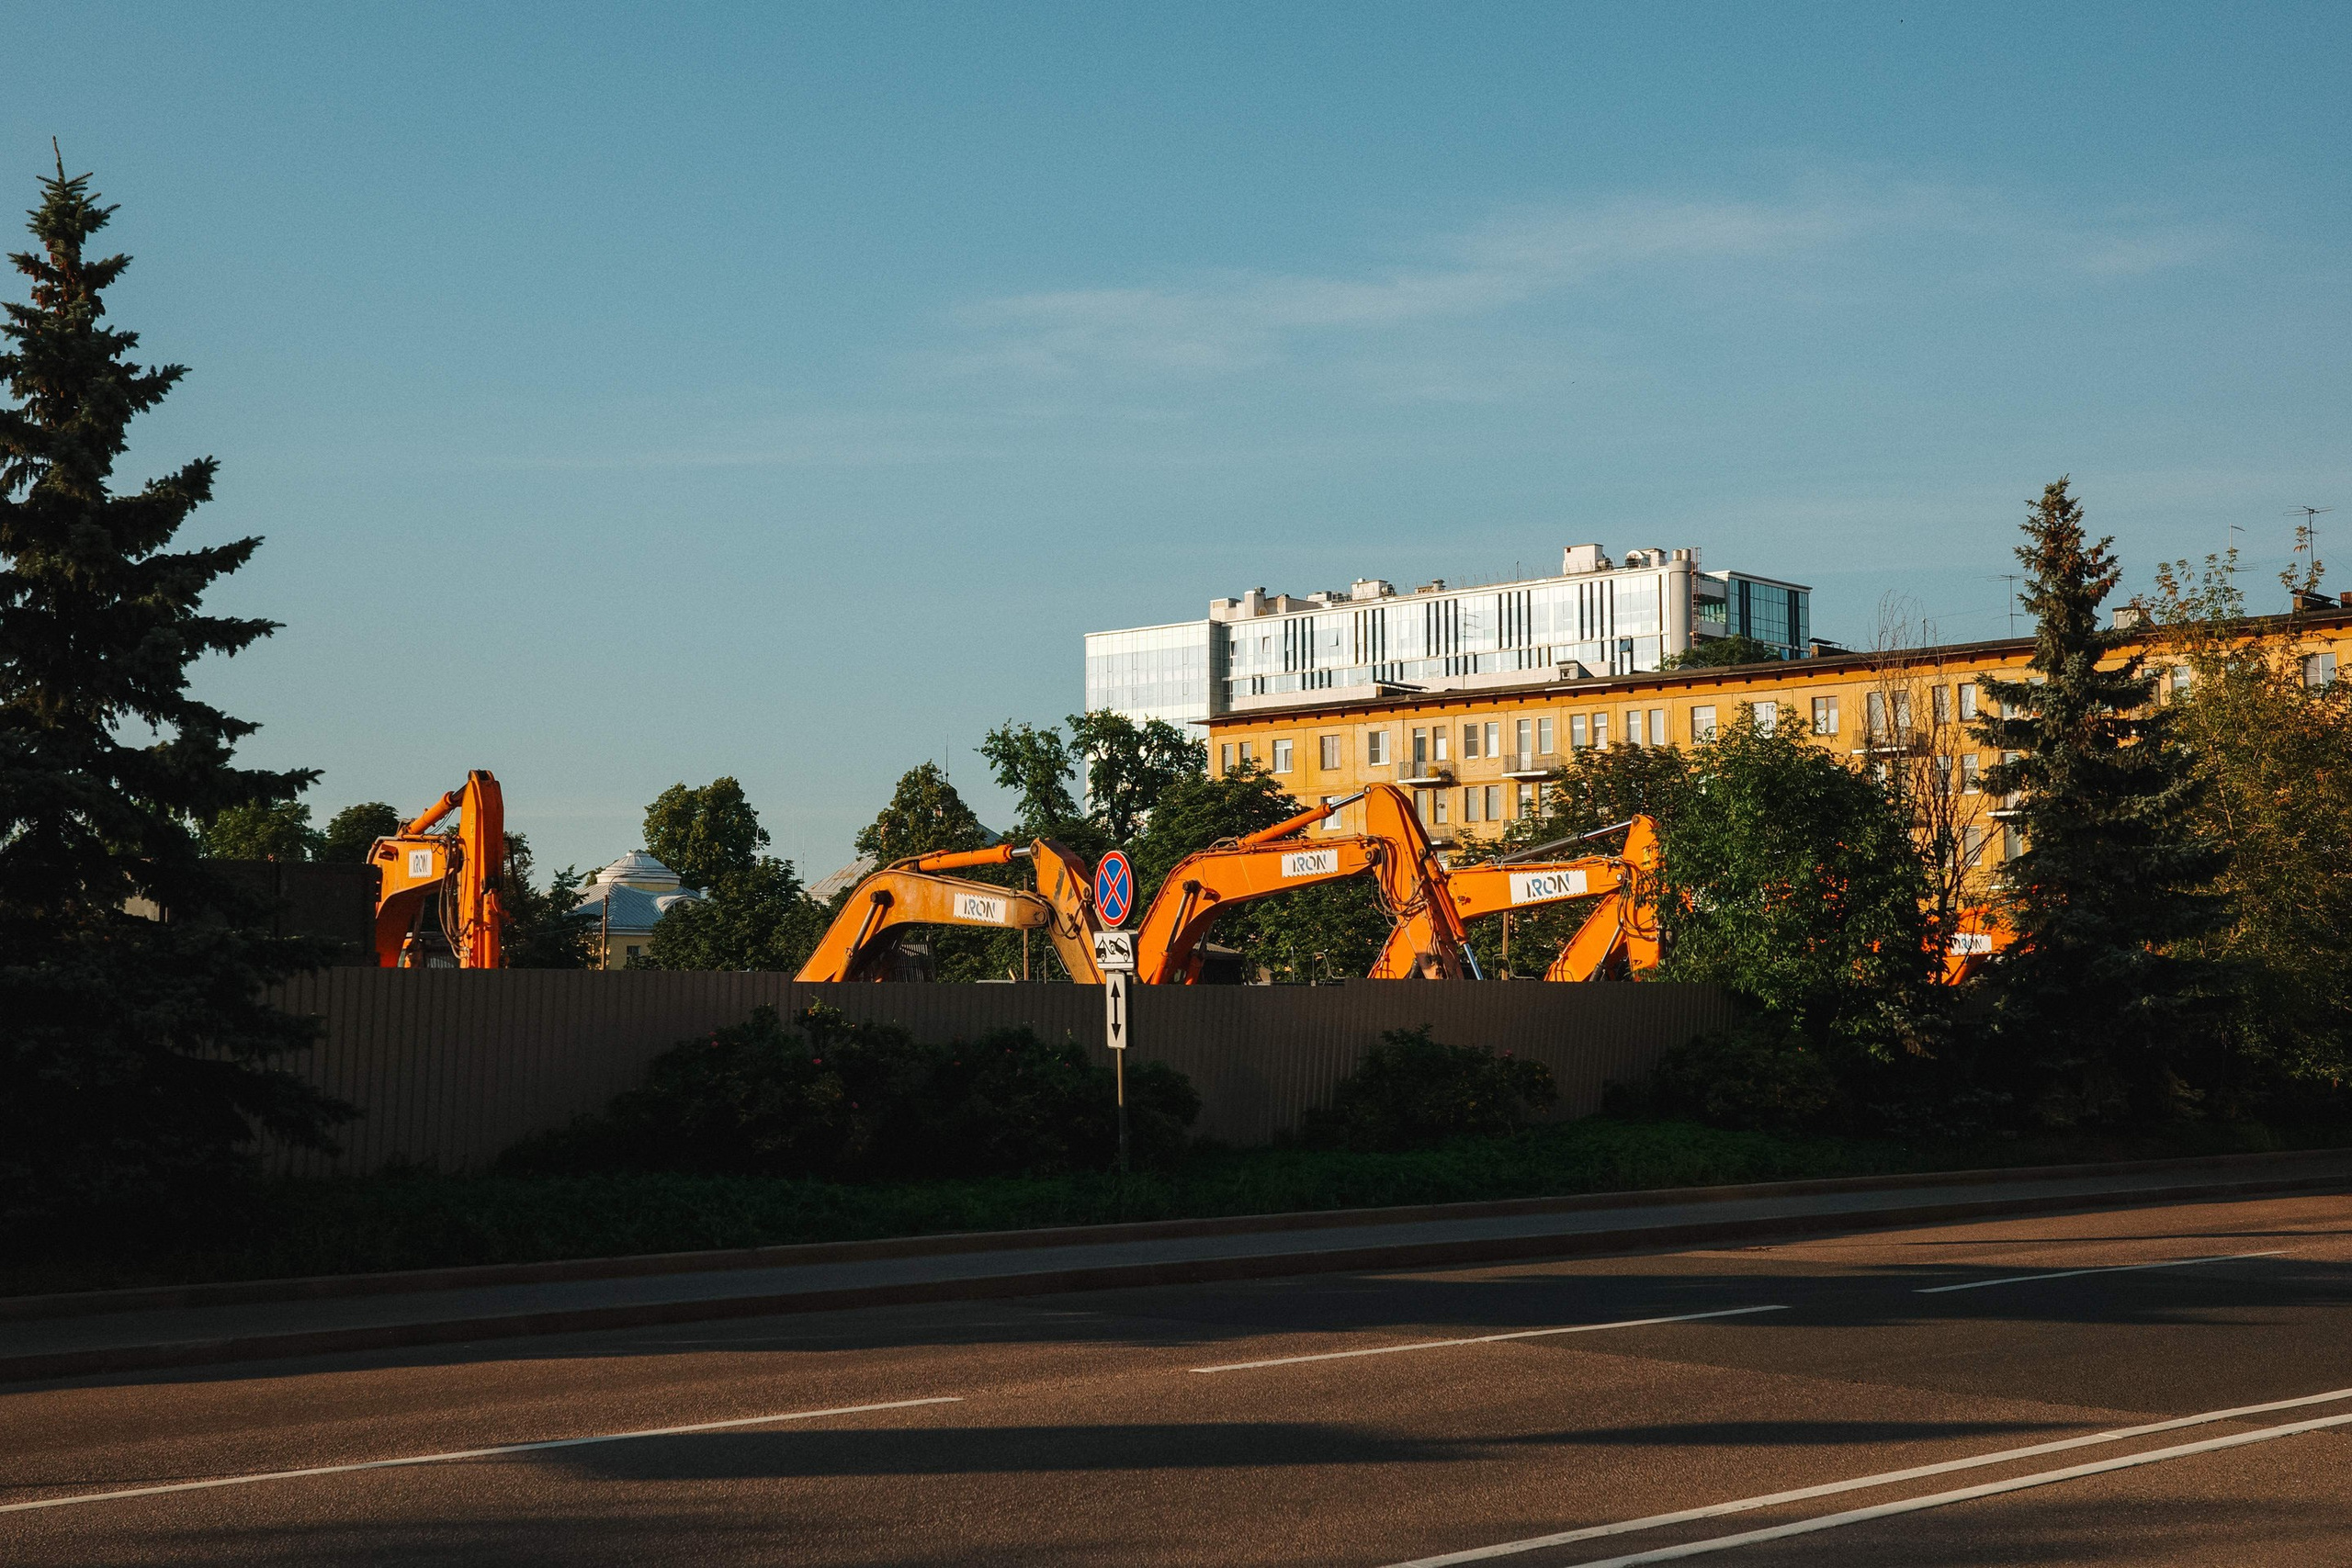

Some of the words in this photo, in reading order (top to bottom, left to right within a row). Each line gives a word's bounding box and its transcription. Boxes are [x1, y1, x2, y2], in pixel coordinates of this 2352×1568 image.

[413, 854, 428, 874] IRON
[1293, 854, 1327, 873] IRON
[1525, 874, 1570, 898] IRON
[964, 898, 996, 919] IRON
